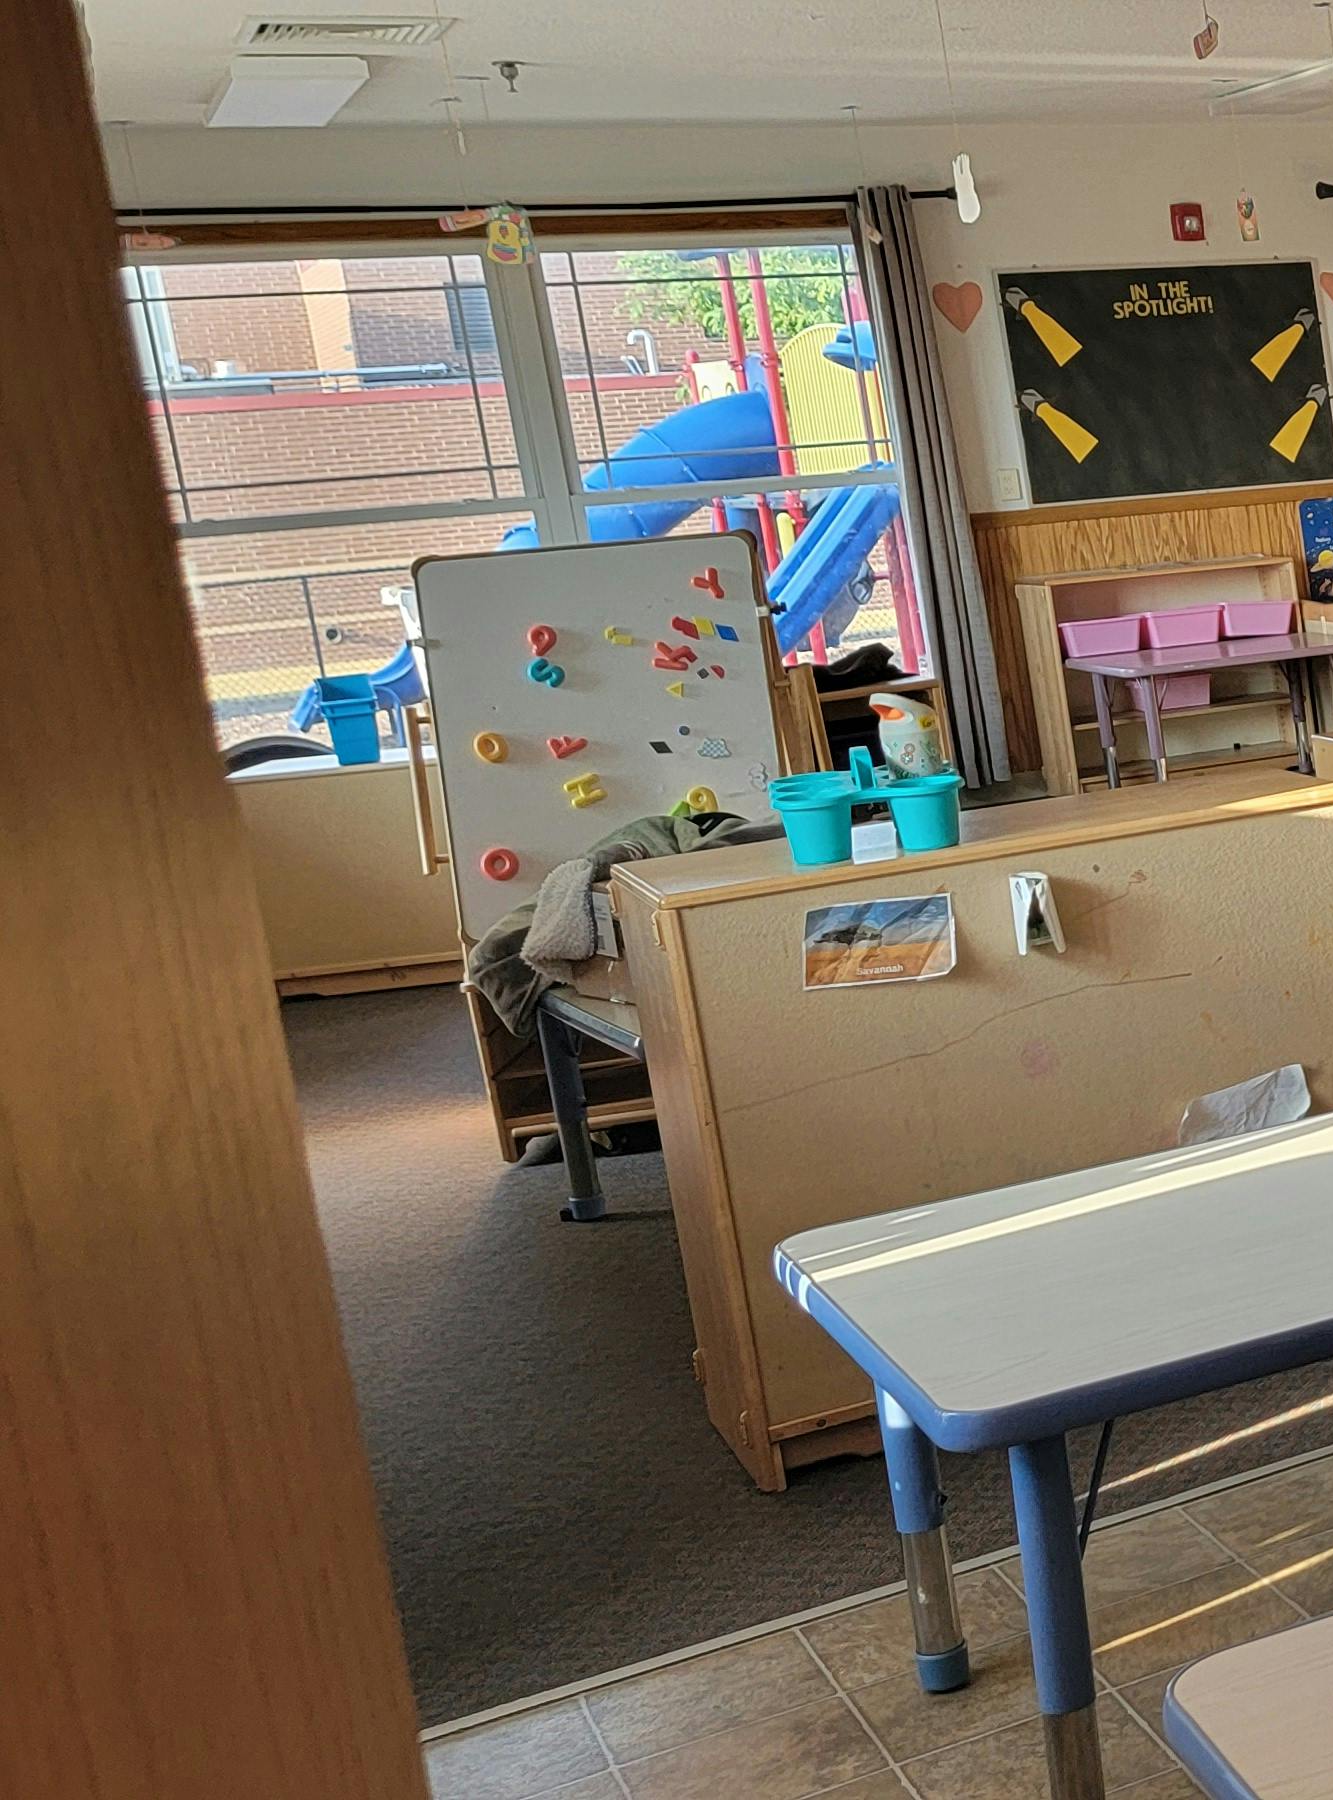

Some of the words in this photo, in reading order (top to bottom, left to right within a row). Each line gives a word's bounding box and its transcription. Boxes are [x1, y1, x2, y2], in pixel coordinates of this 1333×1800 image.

[1129, 283, 1149, 301] IN
[1157, 280, 1191, 299] THE
[1112, 295, 1214, 319] SPOTLIGHT!
[855, 963, 904, 977] Savannah
